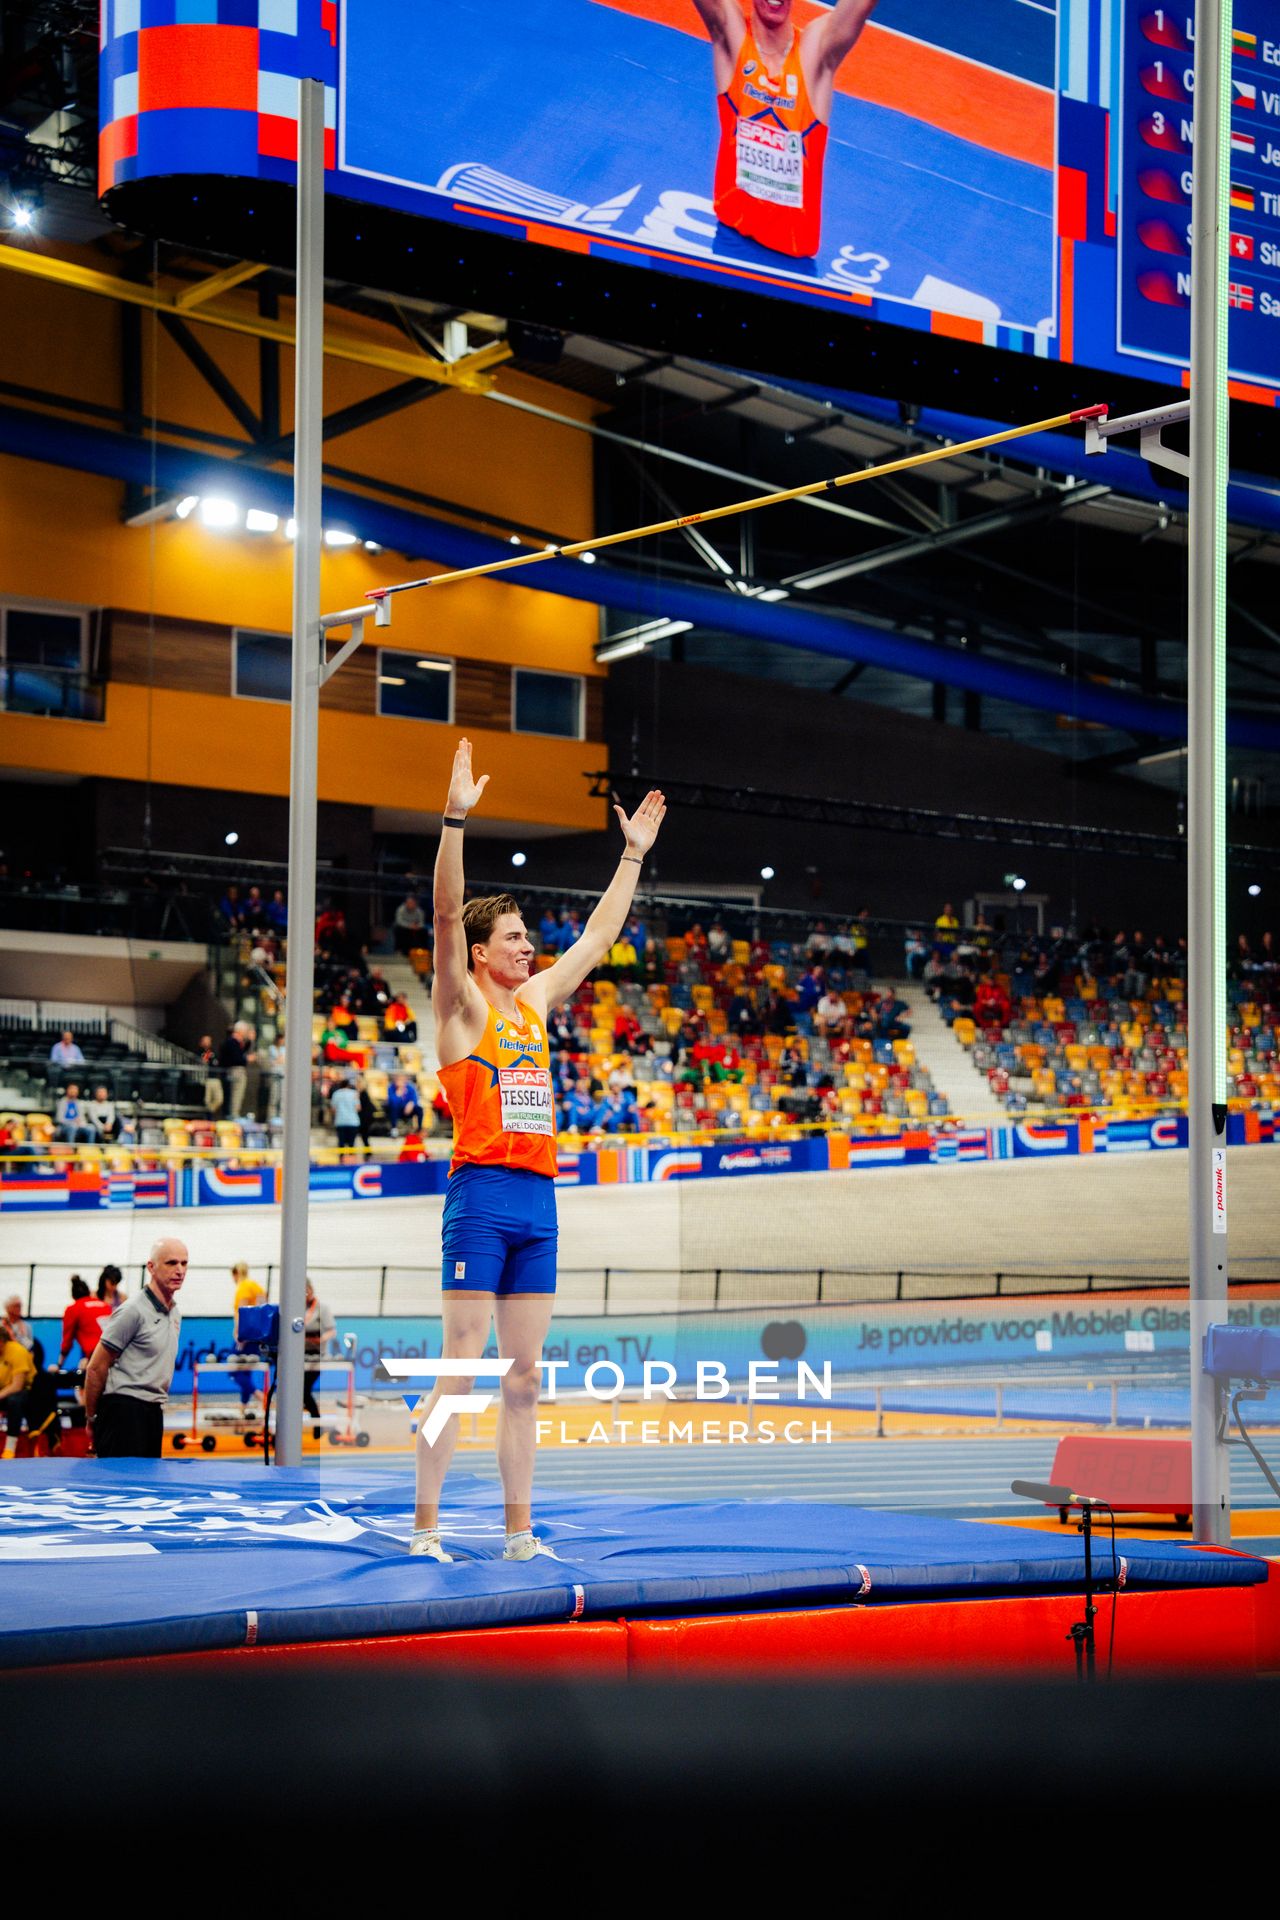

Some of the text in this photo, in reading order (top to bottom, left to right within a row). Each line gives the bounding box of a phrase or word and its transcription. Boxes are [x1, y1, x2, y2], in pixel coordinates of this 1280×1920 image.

[1154, 9, 1164, 31] 1
[1154, 61, 1163, 82] 1
[1152, 111, 1165, 135] 3
[739, 120, 785, 151] SPAR
[501, 1071, 548, 1085] SPAR
[858, 1323, 882, 1350] Je
[888, 1318, 986, 1354] provider
[991, 1318, 1046, 1342] voor
[1052, 1308, 1132, 1337] Mobiel
